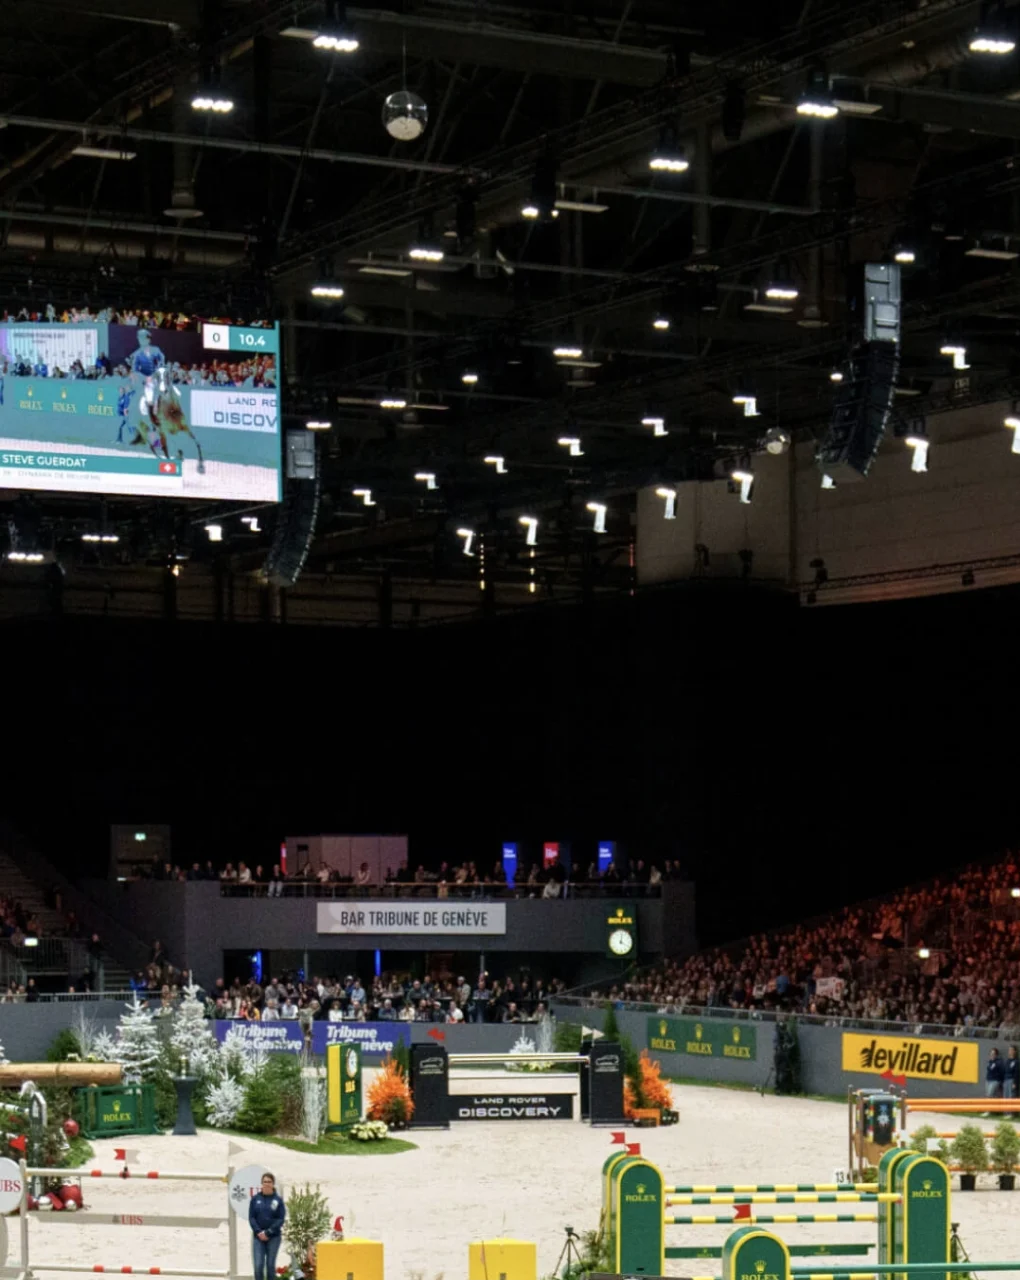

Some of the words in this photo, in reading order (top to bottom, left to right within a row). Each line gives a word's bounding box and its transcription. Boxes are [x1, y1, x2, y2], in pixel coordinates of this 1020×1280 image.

[212, 332, 221, 343] 0
[239, 333, 266, 346] 10.4
[228, 397, 257, 406] LAND
[213, 410, 277, 428] DISCOV
[2, 453, 34, 466] STEVE
[36, 455, 87, 468] GUERDAT
[341, 911, 365, 926] BAR
[369, 911, 420, 926] TRIBUNE
[424, 911, 438, 926] DE
[442, 908, 488, 927] GENÈVE
[236, 1024, 288, 1038] Tribune
[327, 1025, 378, 1038] Tribune
[651, 1038, 676, 1051] ROLEX
[686, 1041, 713, 1055] ROLEX
[724, 1044, 751, 1058] ROLEX
[861, 1039, 959, 1076] devillard
[103, 1112, 131, 1122] ROLEX
[458, 1106, 561, 1118] DISCOVERY
[625, 1194, 656, 1202] ROLEX
[912, 1190, 942, 1198] ROLEX
[121, 1214, 144, 1225] UBS
